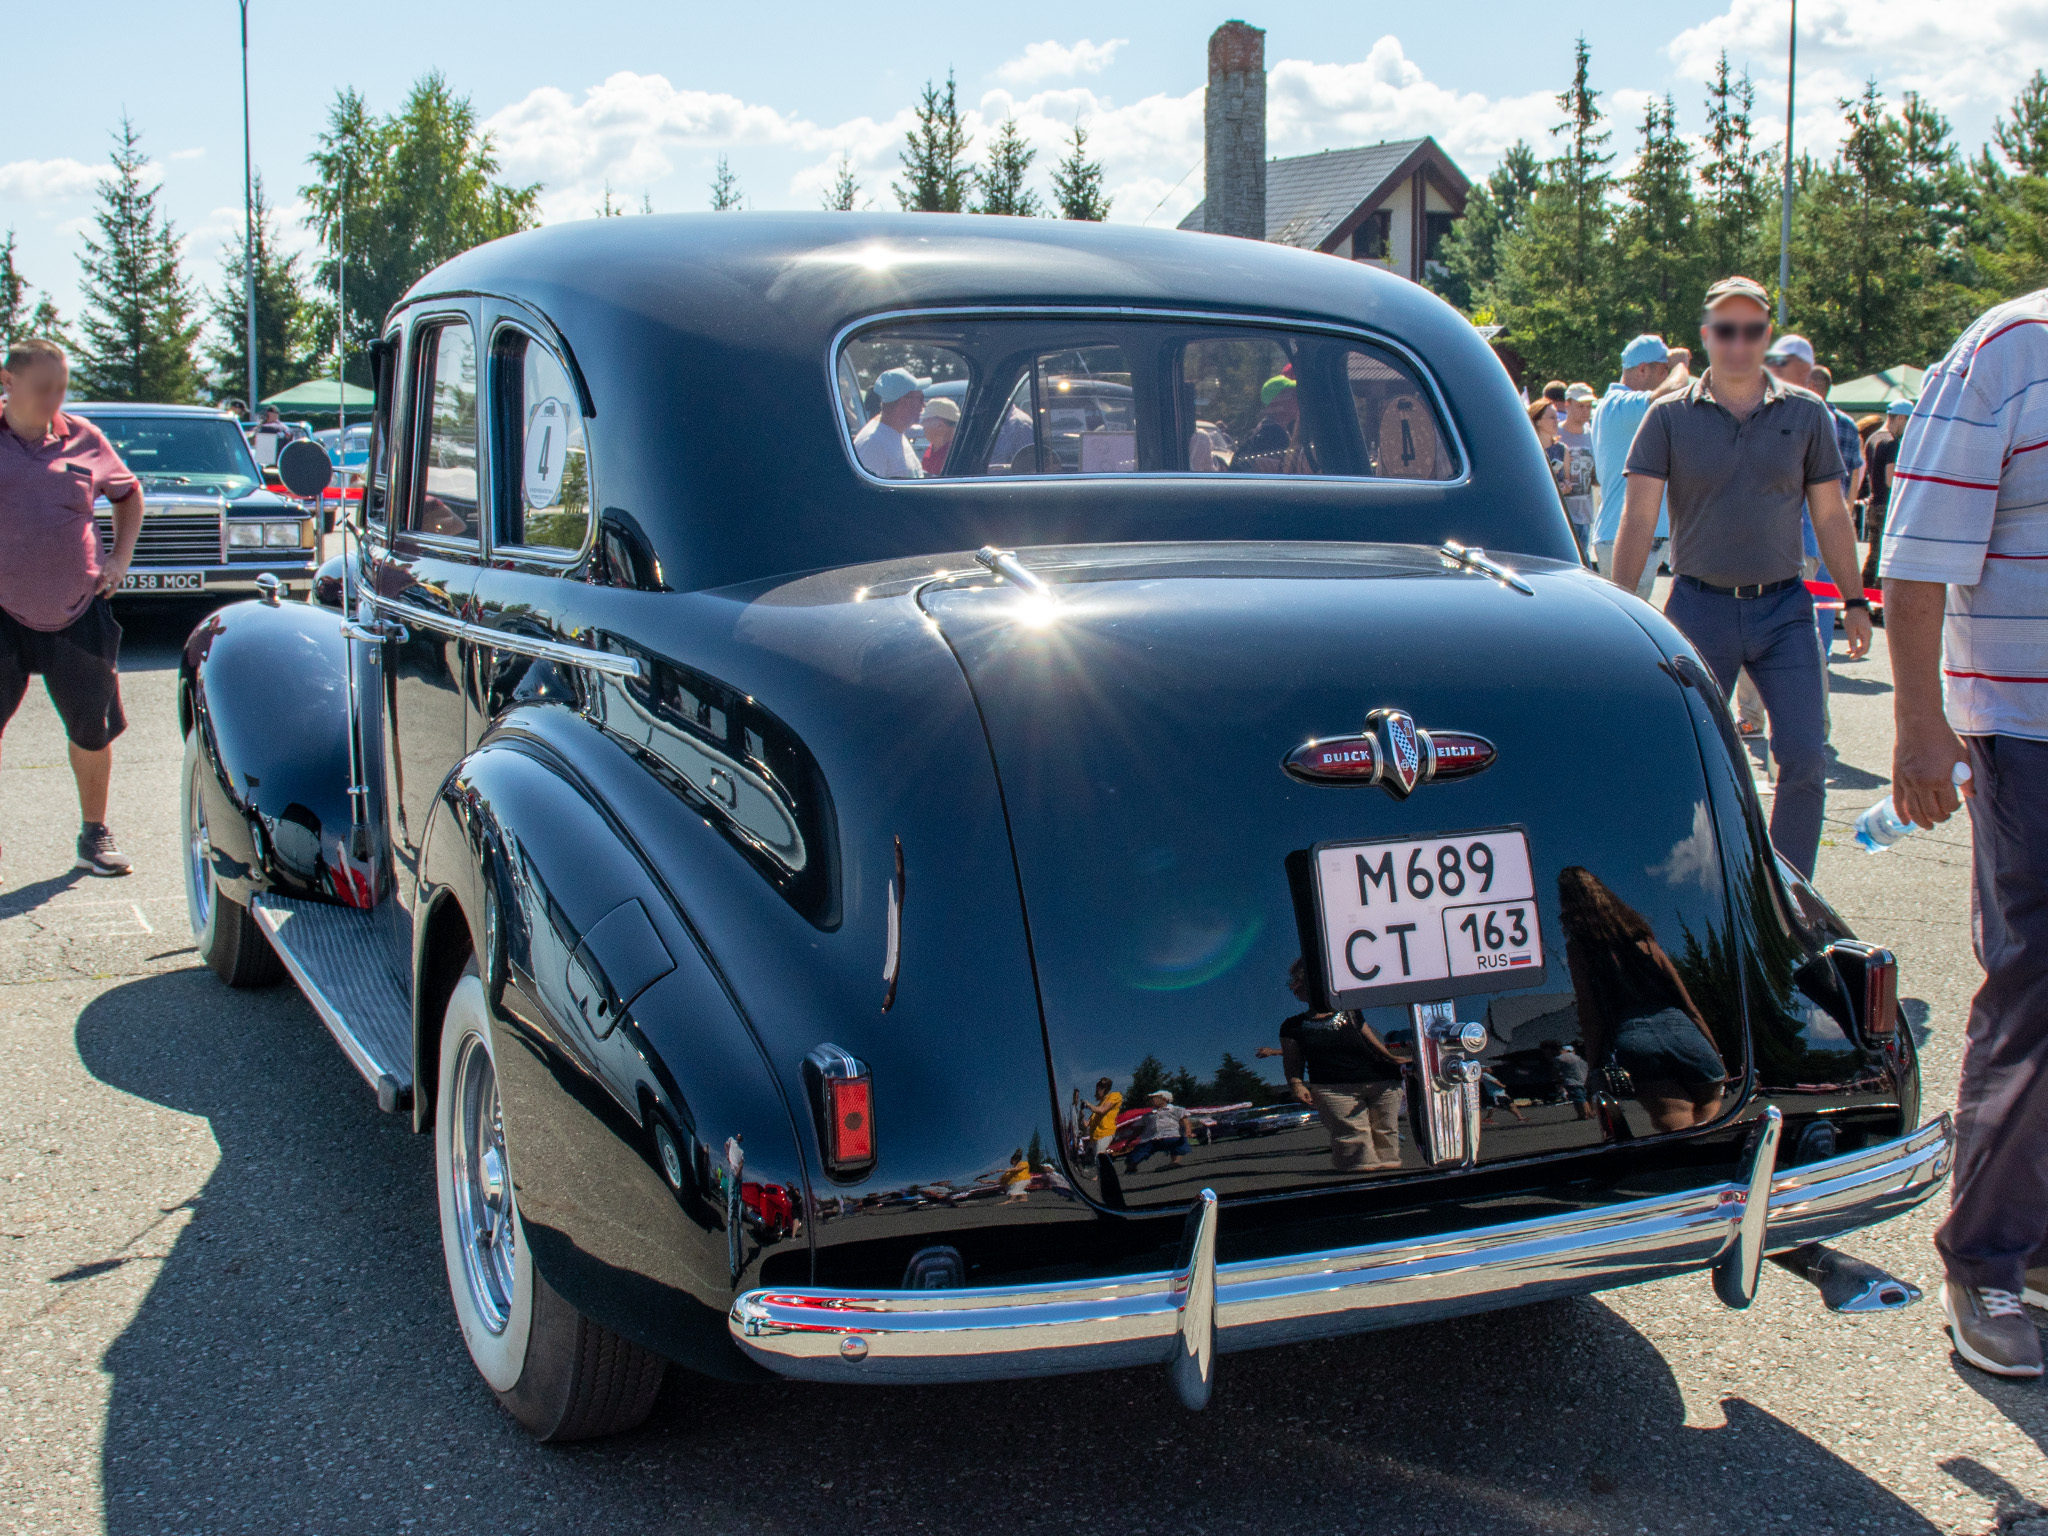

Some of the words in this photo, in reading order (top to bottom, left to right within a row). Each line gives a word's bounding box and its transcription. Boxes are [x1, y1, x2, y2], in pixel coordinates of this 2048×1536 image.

[538, 426, 552, 481] 4
[163, 575, 198, 588] MOC
[1323, 750, 1370, 764] BUICK
[1437, 746, 1476, 757] EIGHT
[1355, 842, 1494, 906] M689
[1345, 922, 1417, 981] CT
[1460, 908, 1528, 952] 163
[1477, 953, 1508, 970] RUS
